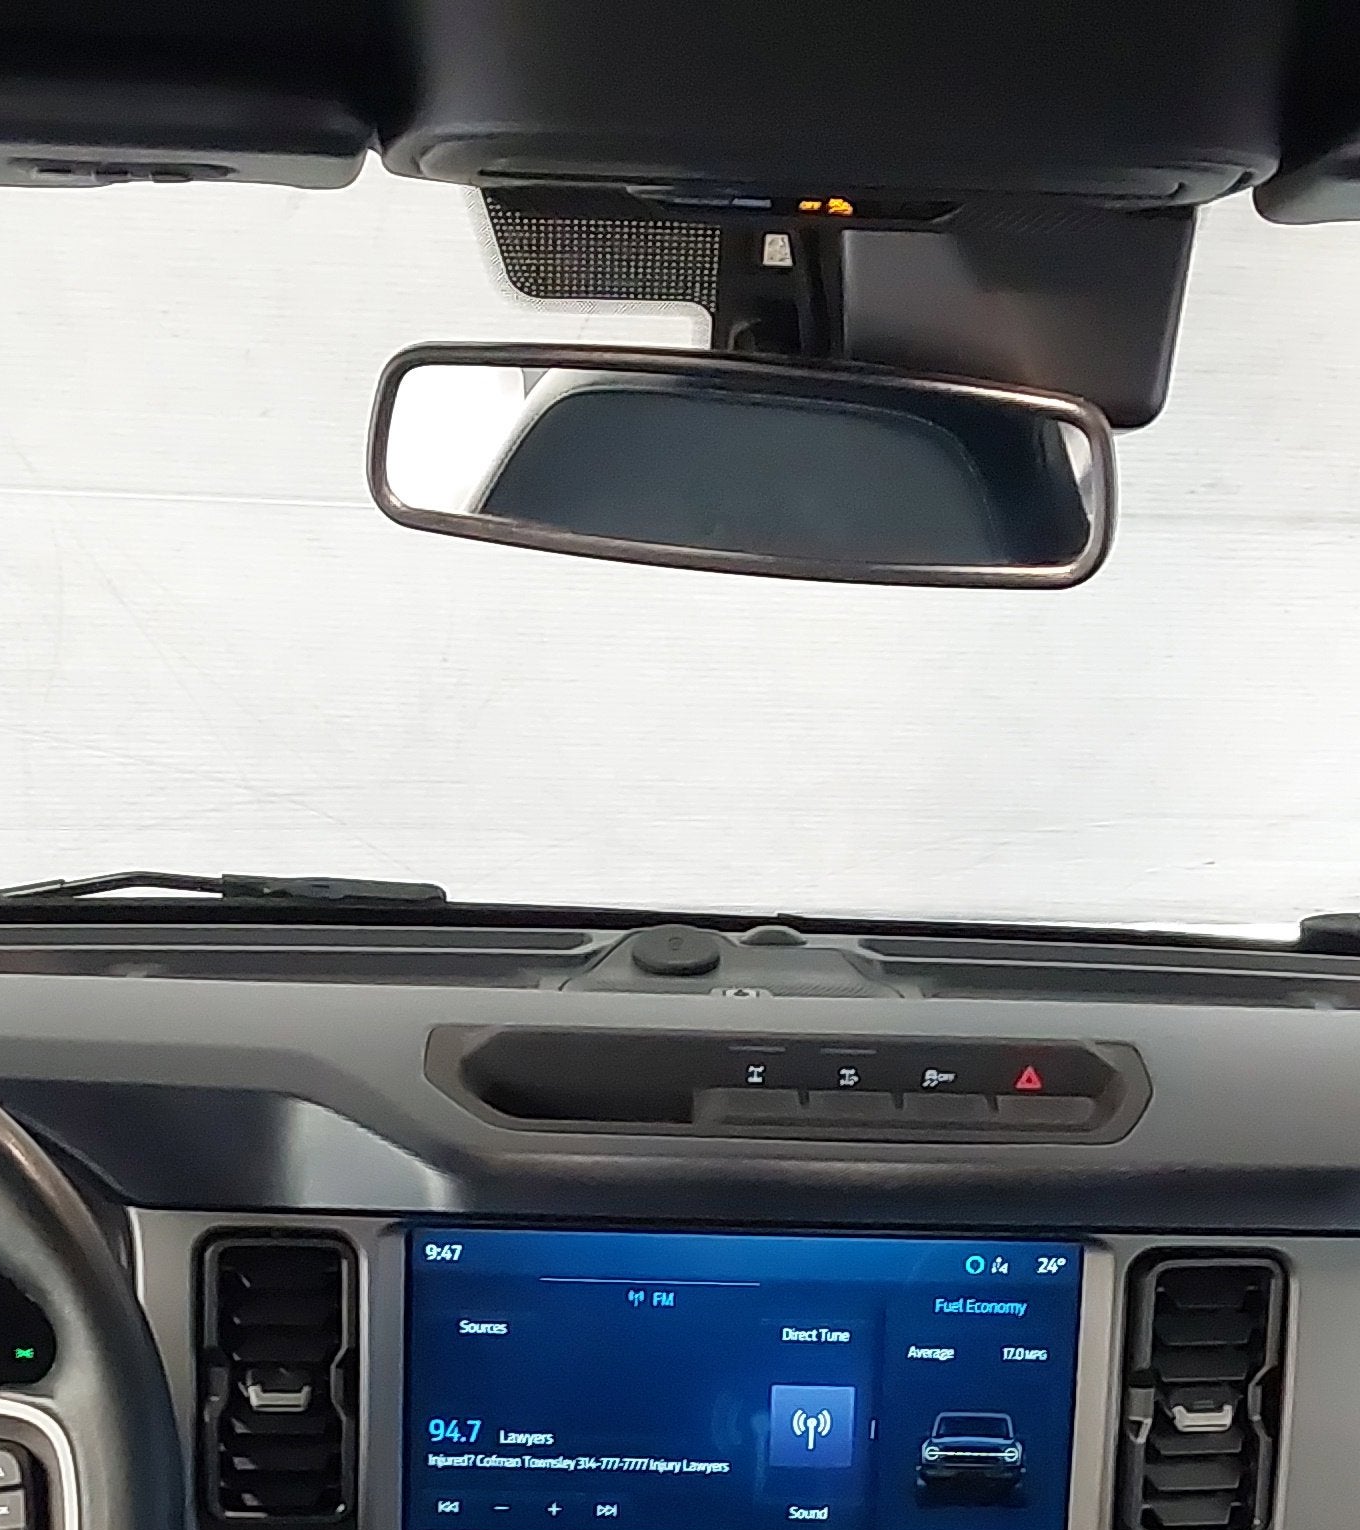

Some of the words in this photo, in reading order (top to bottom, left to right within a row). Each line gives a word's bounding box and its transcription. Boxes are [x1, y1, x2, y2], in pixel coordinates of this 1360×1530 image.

[425, 1243, 463, 1261] 9:47
[1036, 1256, 1067, 1274] 24°
[652, 1292, 674, 1307] FM
[934, 1298, 965, 1314] Fuel
[966, 1299, 1028, 1317] Economy
[459, 1320, 508, 1334] Sources
[782, 1327, 818, 1342] Direct
[819, 1328, 850, 1342] Tune
[907, 1345, 955, 1361] Average
[428, 1418, 482, 1443] 94.7
[499, 1429, 554, 1446] Lawyers
[427, 1453, 475, 1469] Injured?
[577, 1456, 648, 1471] 314-777-7777
[649, 1458, 681, 1475] Injury
[682, 1459, 730, 1475] Lawyers
[788, 1506, 828, 1520] Sound
